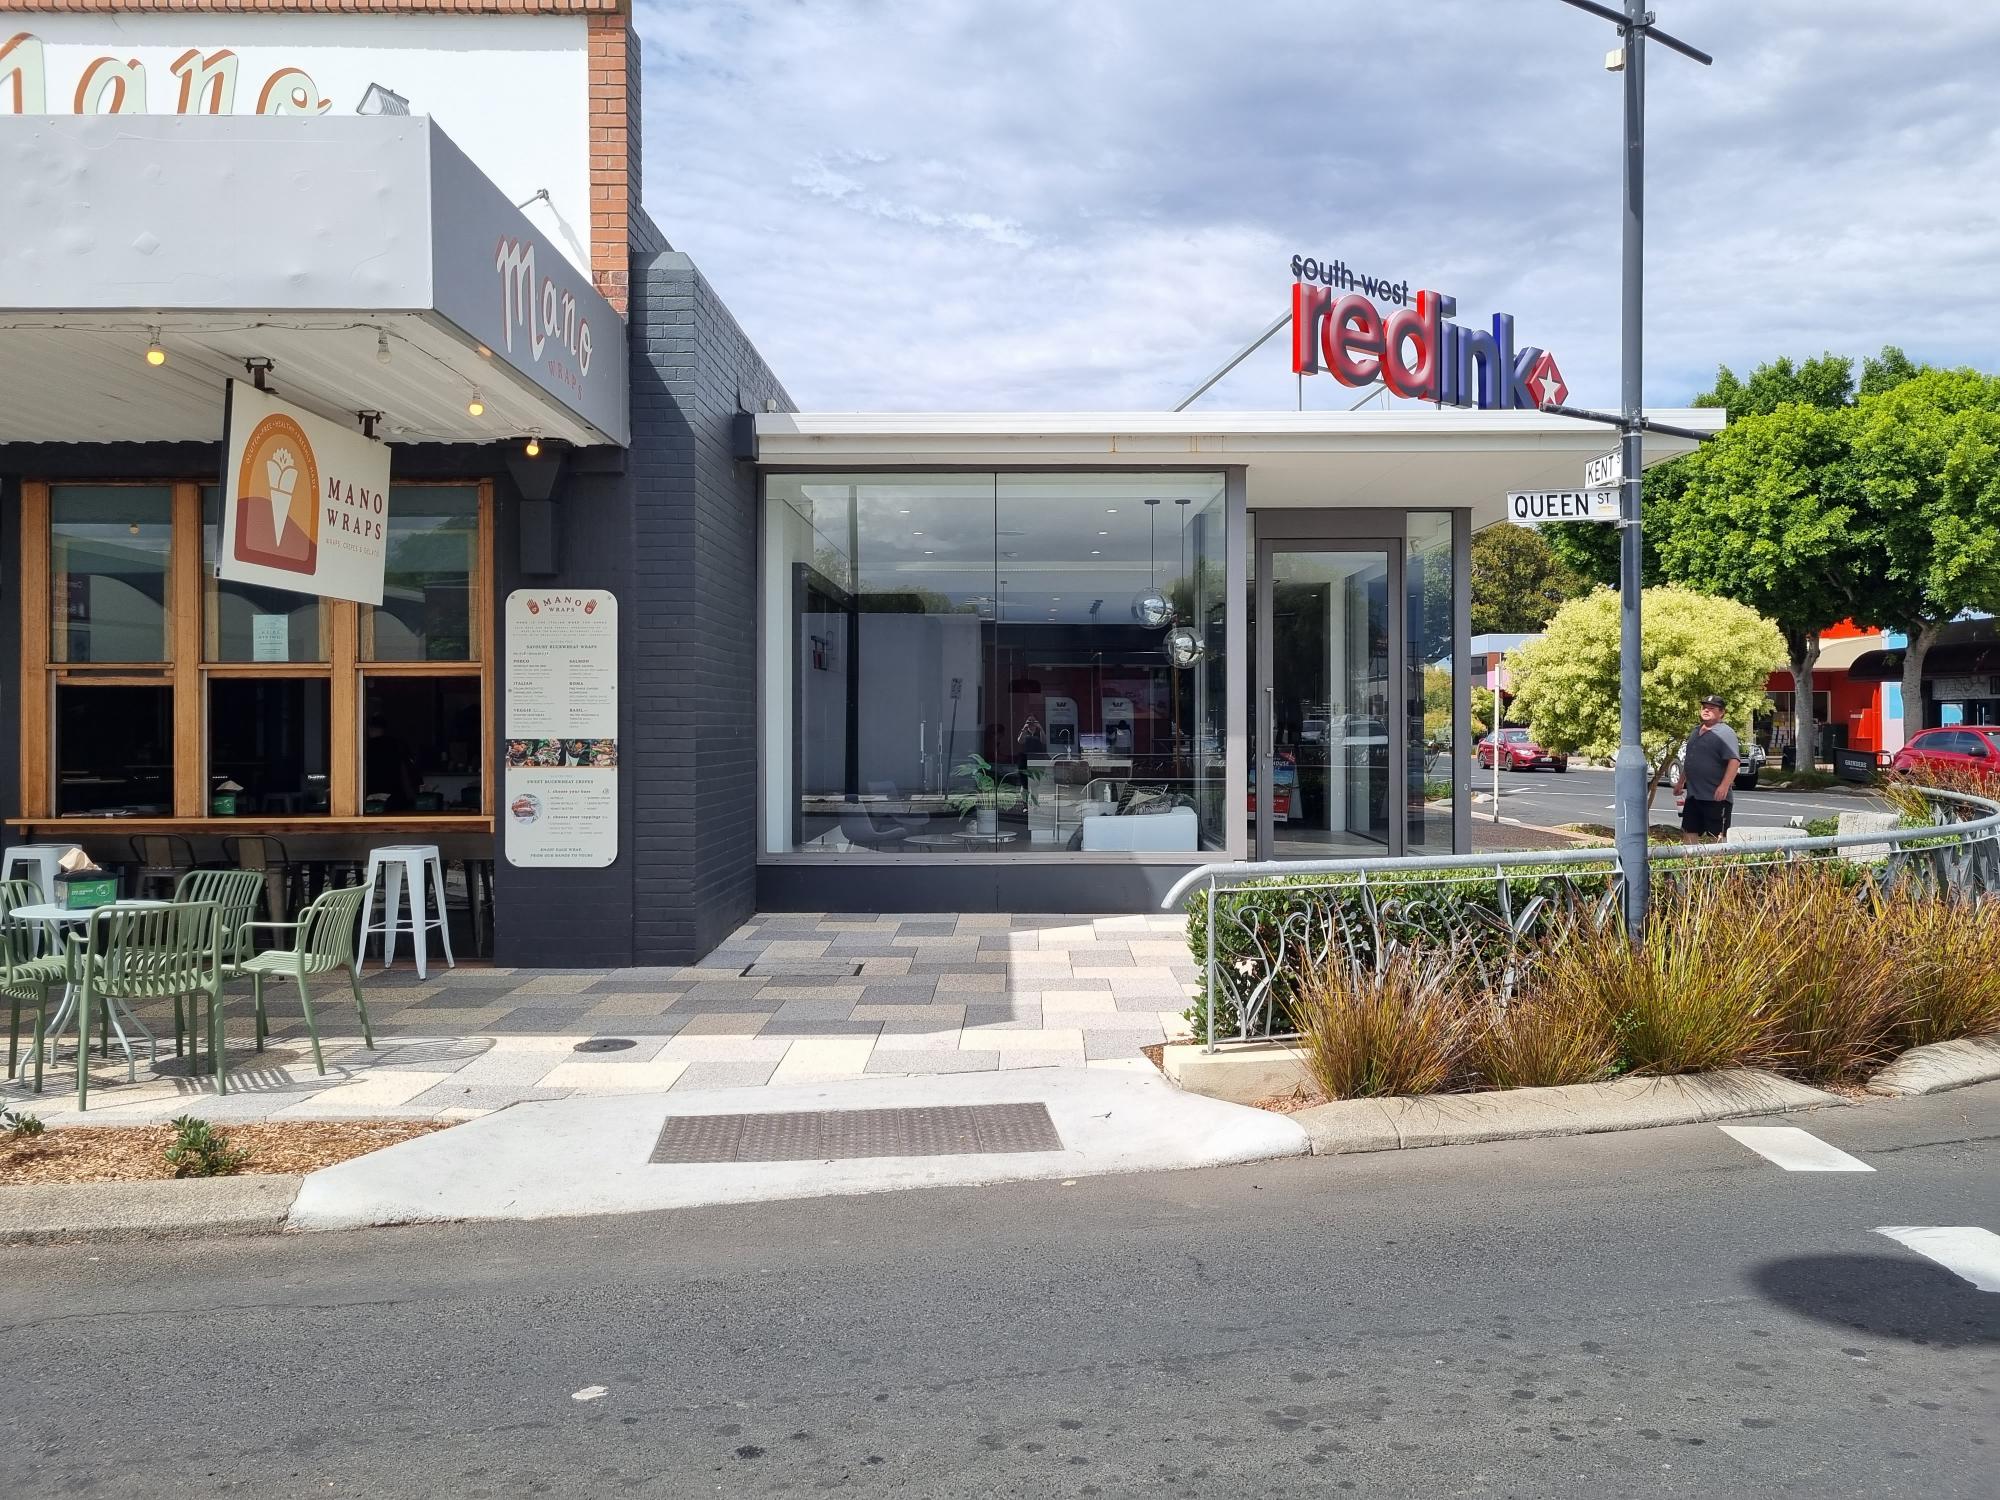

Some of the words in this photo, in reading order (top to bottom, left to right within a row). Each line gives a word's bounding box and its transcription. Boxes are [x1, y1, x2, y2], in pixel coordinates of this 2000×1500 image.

[0, 32, 332, 115] ano
[1291, 254, 1409, 306] south-west
[496, 235, 592, 377] Mano
[549, 360, 583, 400] WRAPS
[1588, 455, 1614, 485] KENT
[328, 476, 382, 514] MANO
[1514, 494, 1589, 518] QUEEN
[1597, 493, 1611, 504] ST
[327, 508, 381, 540] WRAPS
[543, 596, 582, 607] MANO
